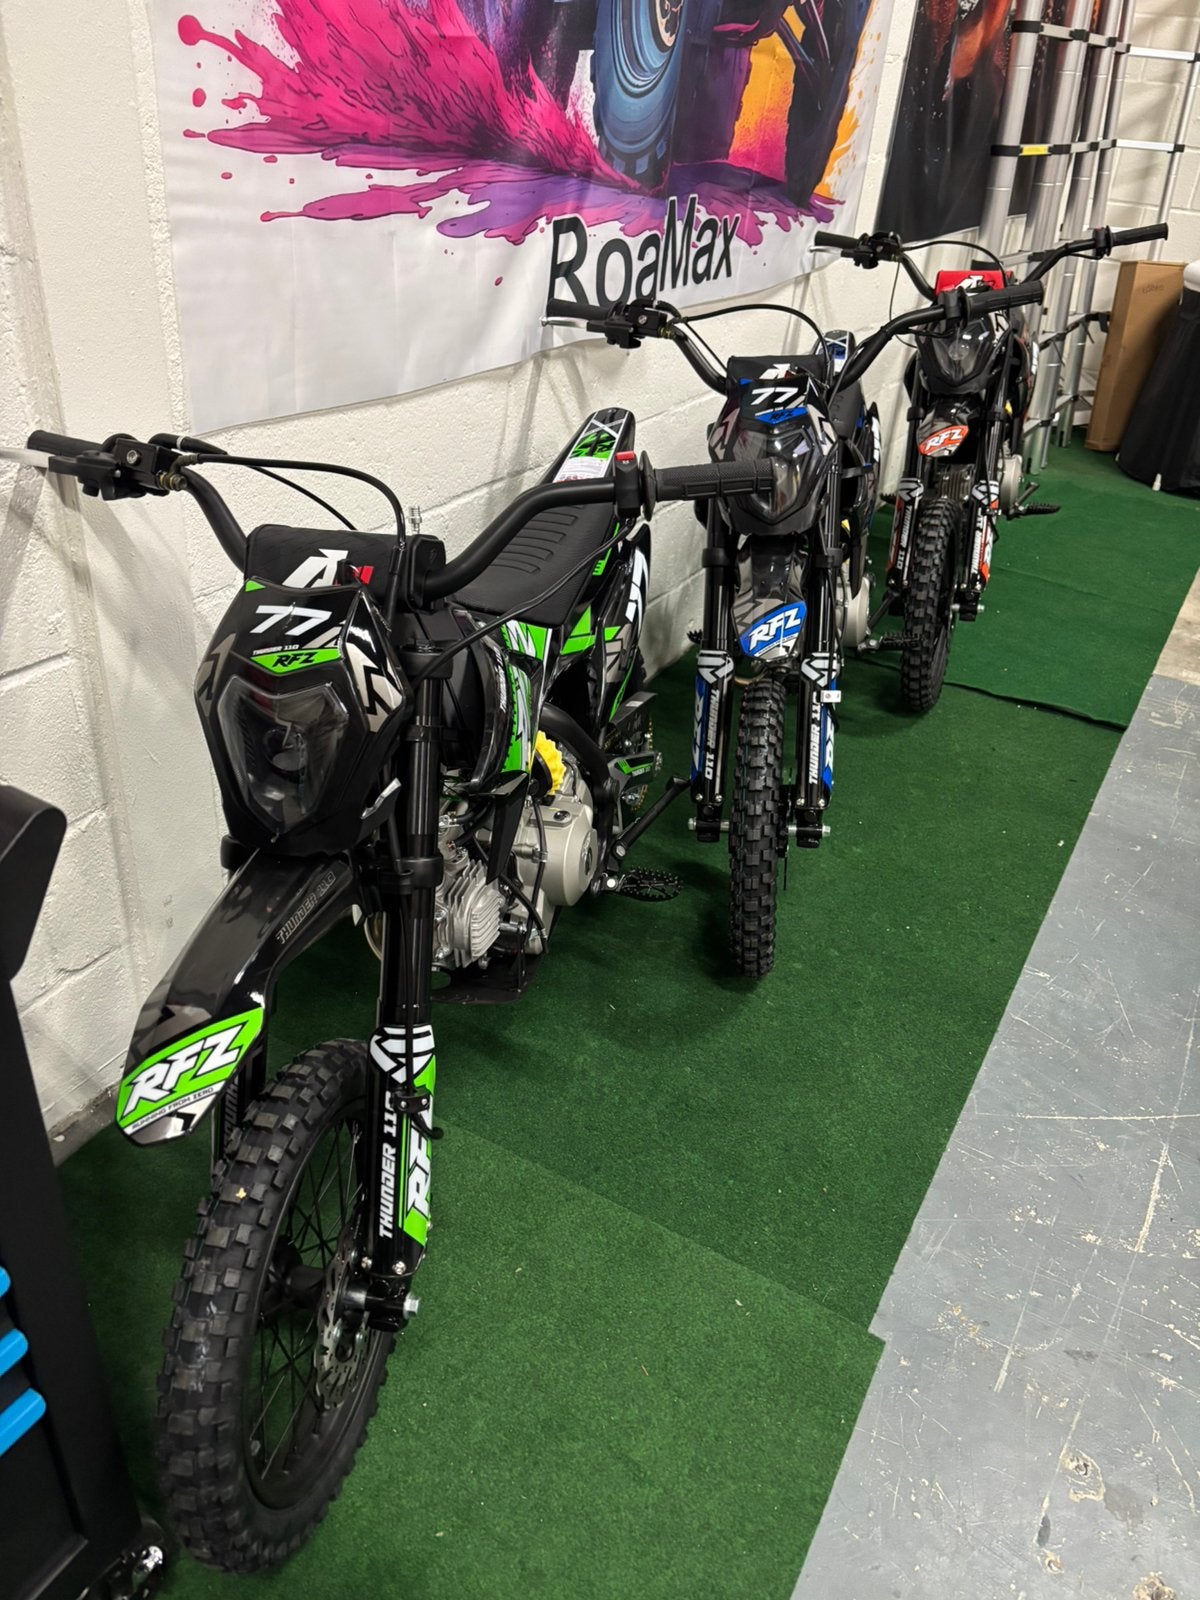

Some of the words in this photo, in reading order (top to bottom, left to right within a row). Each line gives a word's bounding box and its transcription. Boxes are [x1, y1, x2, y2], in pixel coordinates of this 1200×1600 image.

[547, 196, 740, 306] RoaMax
[751, 387, 799, 405] 77
[925, 428, 963, 451] RFZ
[249, 604, 333, 637] 77
[748, 607, 802, 651] RFZ
[271, 651, 318, 668] RFZ
[706, 688, 720, 750] THUNDER
[704, 751, 715, 780] 110
[808, 723, 821, 785] THUNDER
[275, 892, 318, 945] THUNDER
[121, 1022, 246, 1119] RFZ
[131, 1107, 168, 1131] RUNNING
[167, 1096, 192, 1111] FROM
[192, 1087, 214, 1101] ZERO
[378, 1142, 398, 1239] THUNDER
